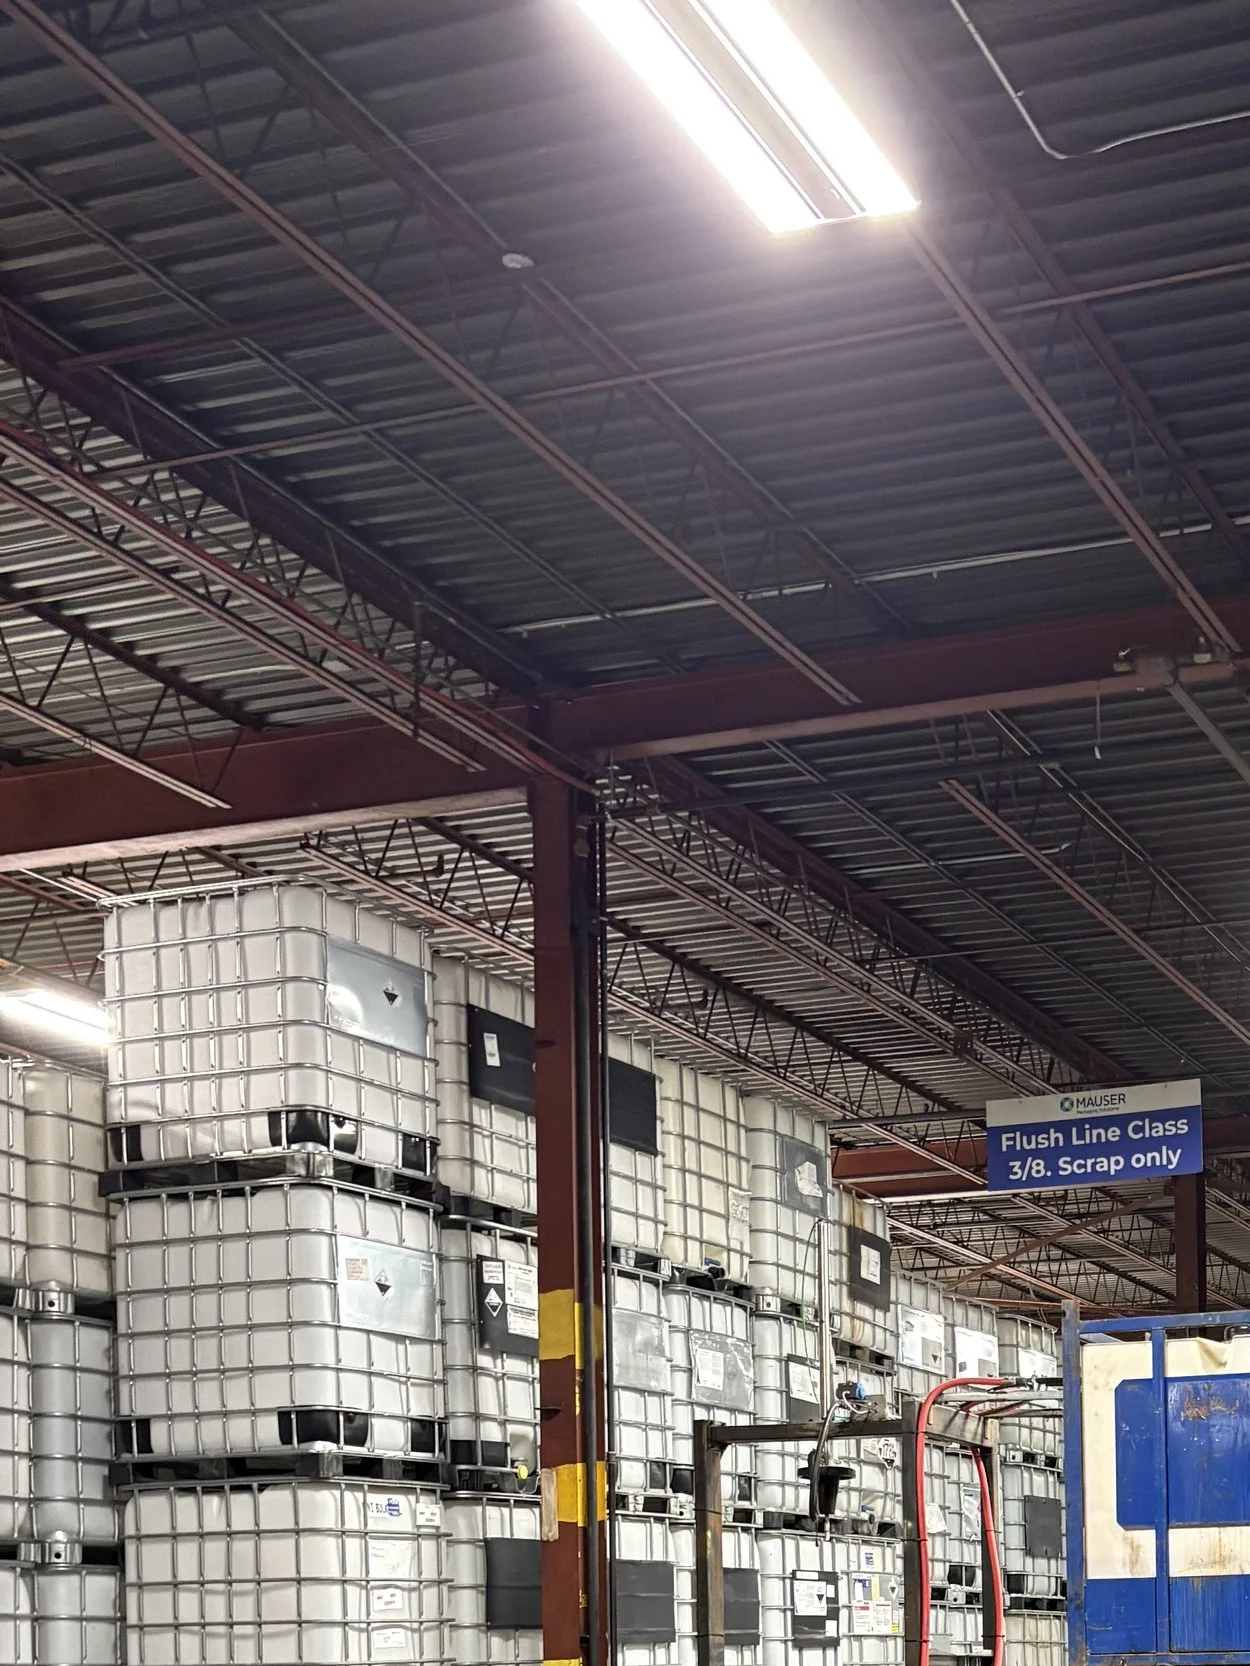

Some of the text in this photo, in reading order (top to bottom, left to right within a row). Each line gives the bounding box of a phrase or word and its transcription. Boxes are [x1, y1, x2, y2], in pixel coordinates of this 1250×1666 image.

[1076, 1093, 1126, 1109] MAUSER
[1001, 1118, 1189, 1152] Flush Line Class
[1008, 1145, 1182, 1181] 3/8. Scrap only
